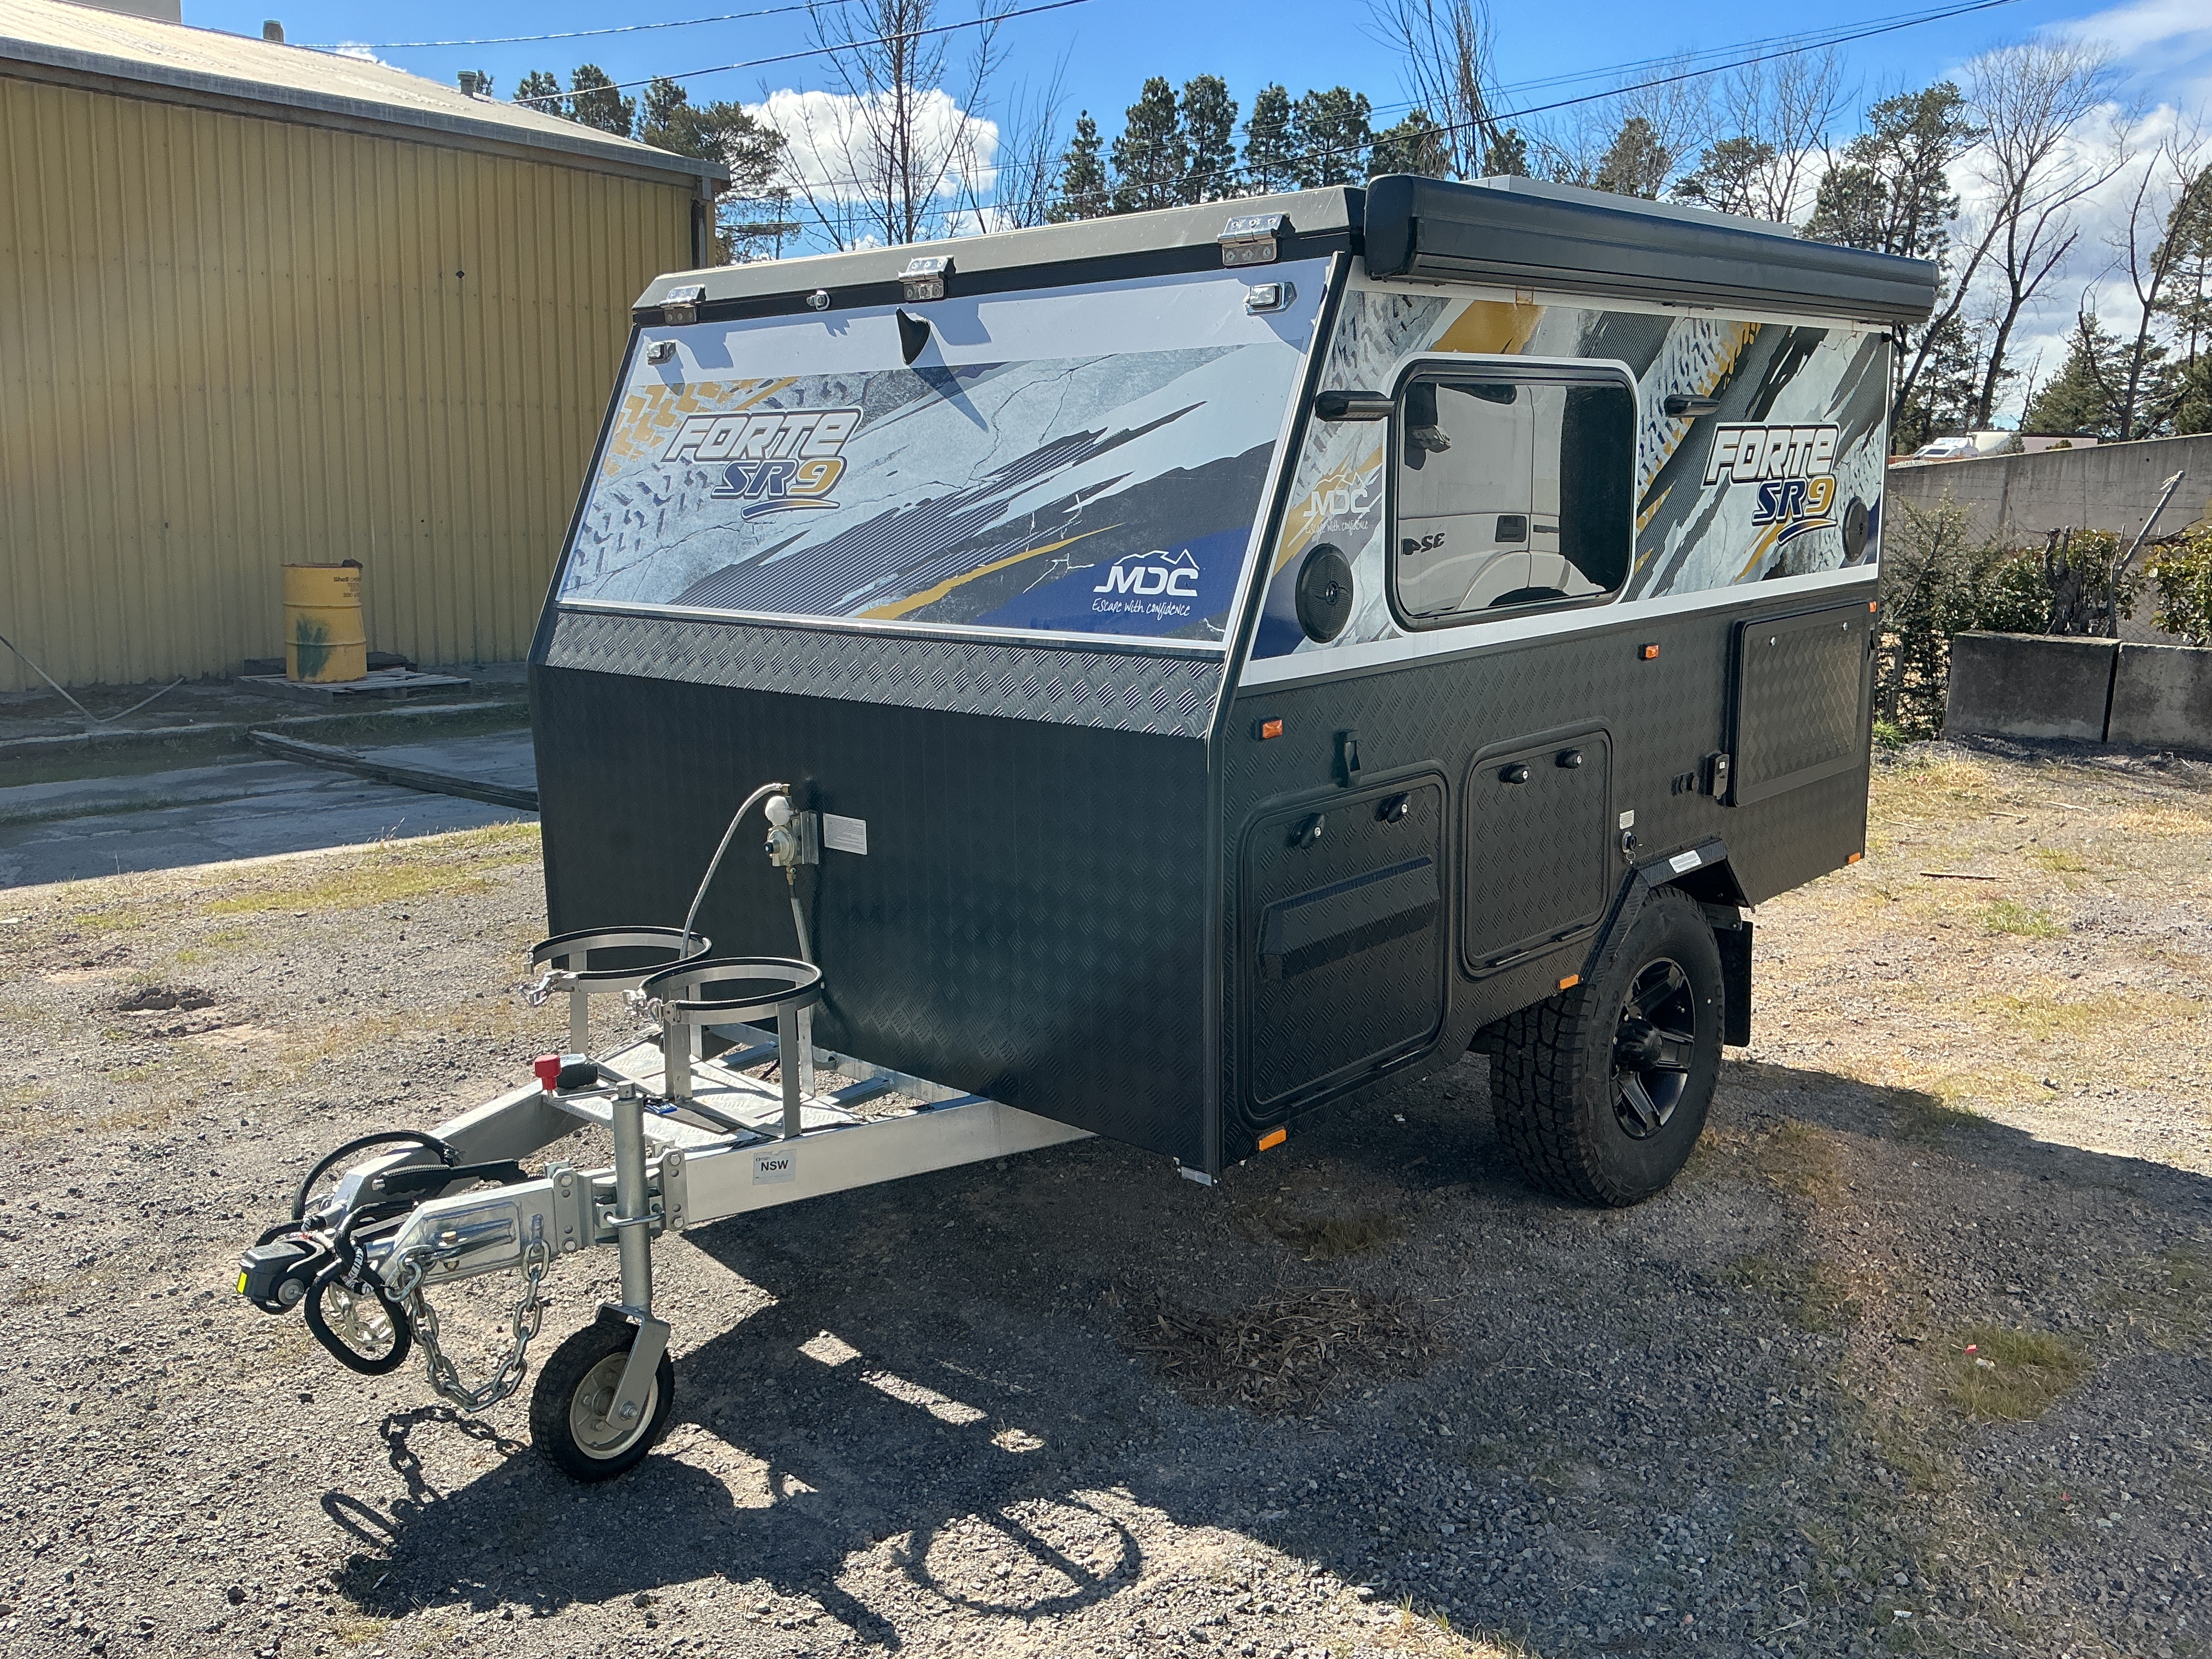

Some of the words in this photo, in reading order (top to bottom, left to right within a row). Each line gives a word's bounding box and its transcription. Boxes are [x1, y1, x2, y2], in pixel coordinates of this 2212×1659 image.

[662, 407, 862, 462] FORTE
[1702, 424, 1839, 486] FORTE
[711, 457, 847, 499] SR9
[1303, 489, 1370, 517] MDC
[1752, 475, 1836, 526] SR9
[1093, 566, 1199, 597] MDC
[1092, 597, 1122, 613] Escape
[1124, 599, 1145, 613] with
[760, 1159, 789, 1172] NSW
